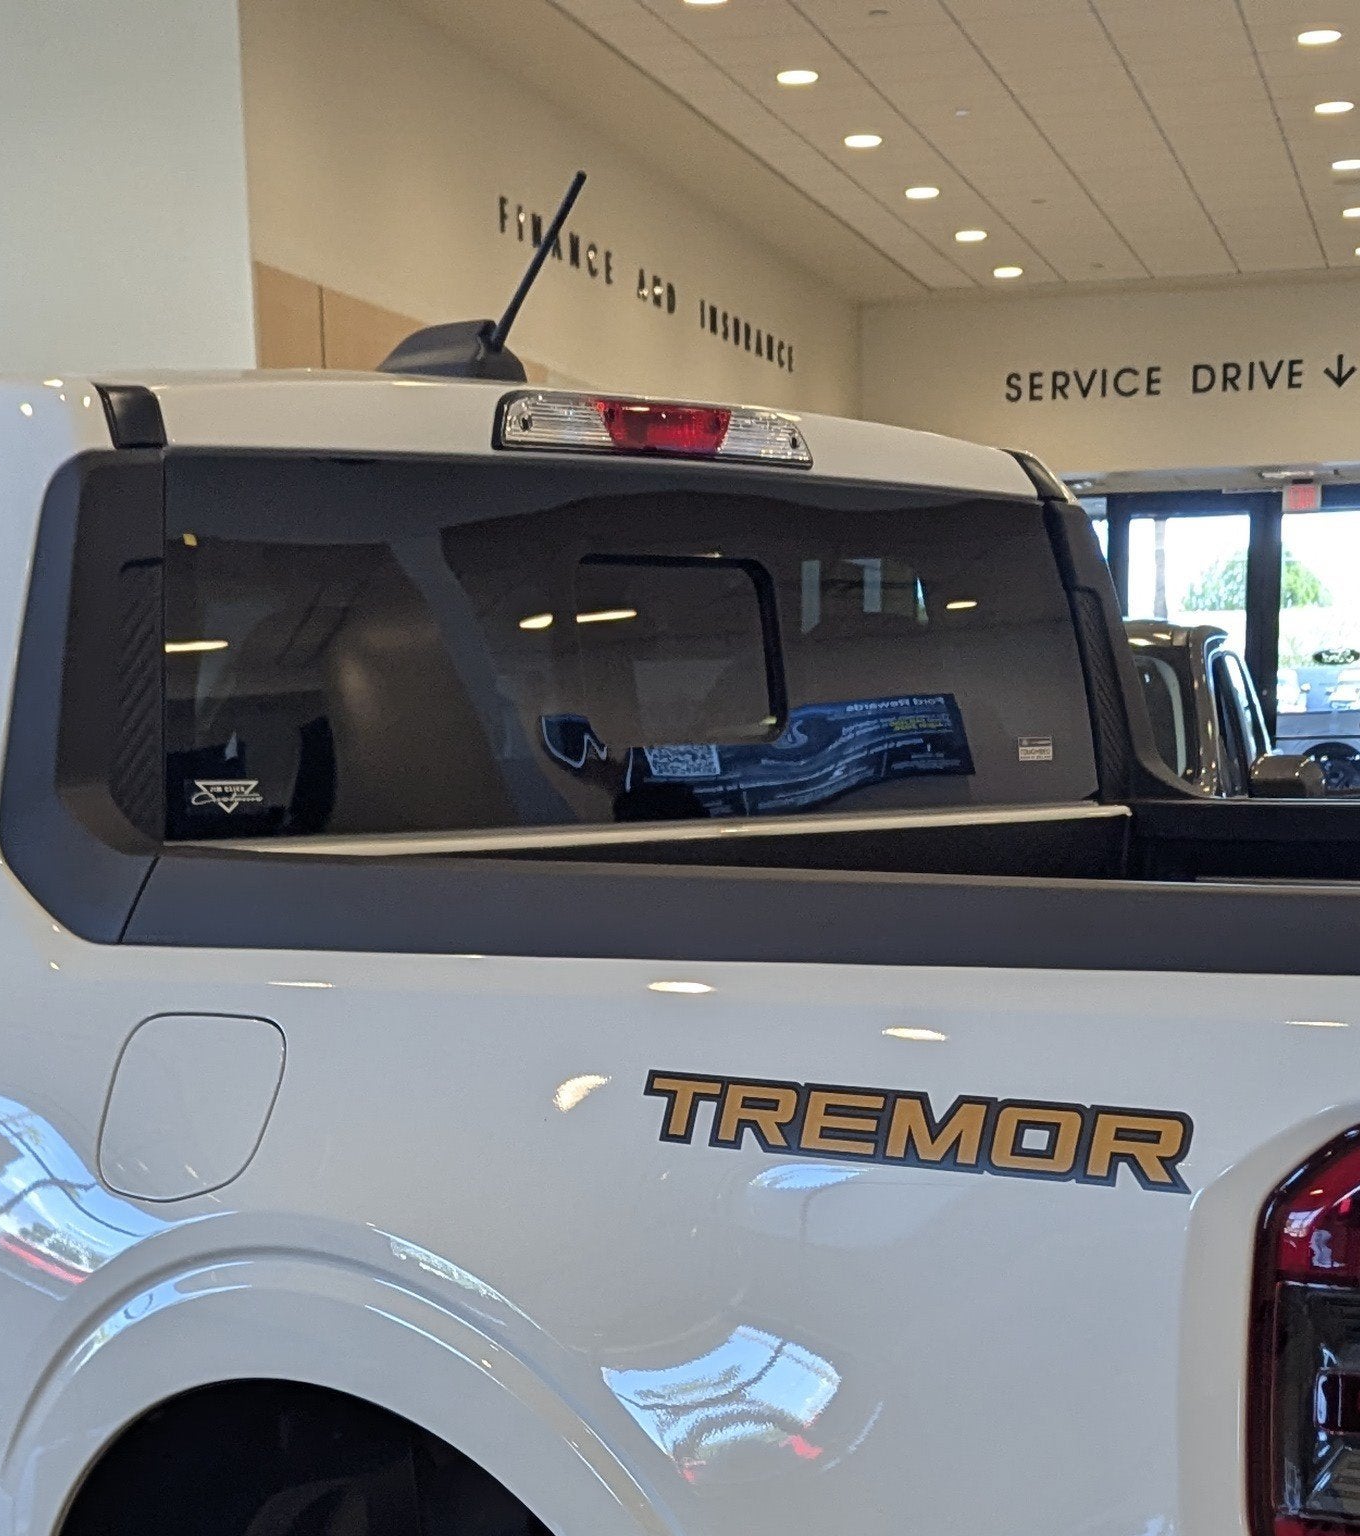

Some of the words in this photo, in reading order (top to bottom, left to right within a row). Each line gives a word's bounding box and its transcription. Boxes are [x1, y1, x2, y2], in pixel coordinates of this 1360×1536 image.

[498, 196, 613, 284] FINANCE
[637, 269, 676, 314] AND
[700, 299, 794, 373] INSURANCE
[1005, 366, 1162, 403] SERVICE
[1192, 359, 1304, 395] DRIVE
[643, 1069, 1175, 1194] TREMOR
